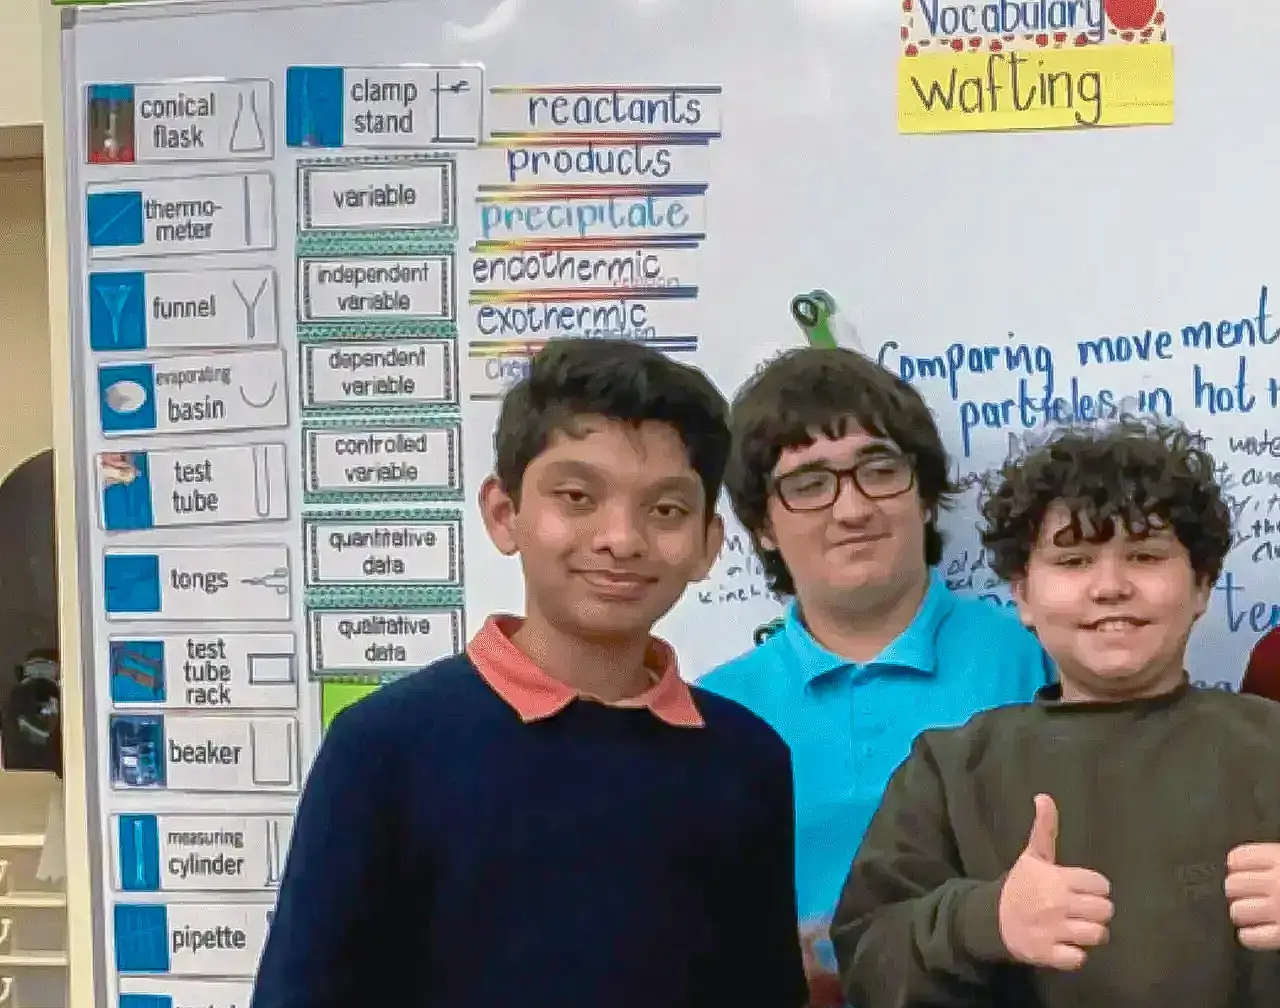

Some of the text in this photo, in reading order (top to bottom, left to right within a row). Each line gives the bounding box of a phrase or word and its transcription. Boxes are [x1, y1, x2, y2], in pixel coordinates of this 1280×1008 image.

[918, 0, 1105, 44] Vocabulary
[350, 78, 419, 106] clamp
[910, 51, 1101, 125] wafting
[140, 91, 216, 119] conical
[529, 91, 702, 125] reactants
[354, 110, 413, 135] stand
[153, 124, 205, 149] flask
[506, 141, 671, 182] products
[333, 184, 417, 209] variable
[145, 197, 223, 223] thermo-
[481, 196, 690, 239] precipitate
[156, 221, 213, 243] meter
[317, 262, 430, 289] independent
[472, 250, 661, 284] endothermic
[153, 294, 217, 319] funnel
[337, 290, 411, 311] variable
[477, 300, 648, 335] exothermic
[328, 346, 427, 373] dependent
[877, 332, 1053, 401] Comparing
[342, 374, 416, 396] variable
[1138, 386, 1172, 417] in
[1193, 357, 1256, 419] hot
[168, 394, 224, 423] basin
[335, 433, 428, 456] controlled
[174, 459, 213, 484] test
[344, 461, 419, 483] variable
[172, 487, 219, 515] tube
[329, 527, 437, 553] quantitative
[362, 555, 405, 576] data
[171, 568, 229, 594] tongs
[338, 615, 430, 640] qualitative
[187, 638, 226, 660] test
[364, 642, 407, 662] data
[183, 661, 231, 682] tube
[185, 682, 231, 705] rack
[169, 740, 242, 765] beaker
[167, 827, 244, 849] measuring
[167, 853, 246, 880] cylinder
[172, 925, 247, 954] pipette
